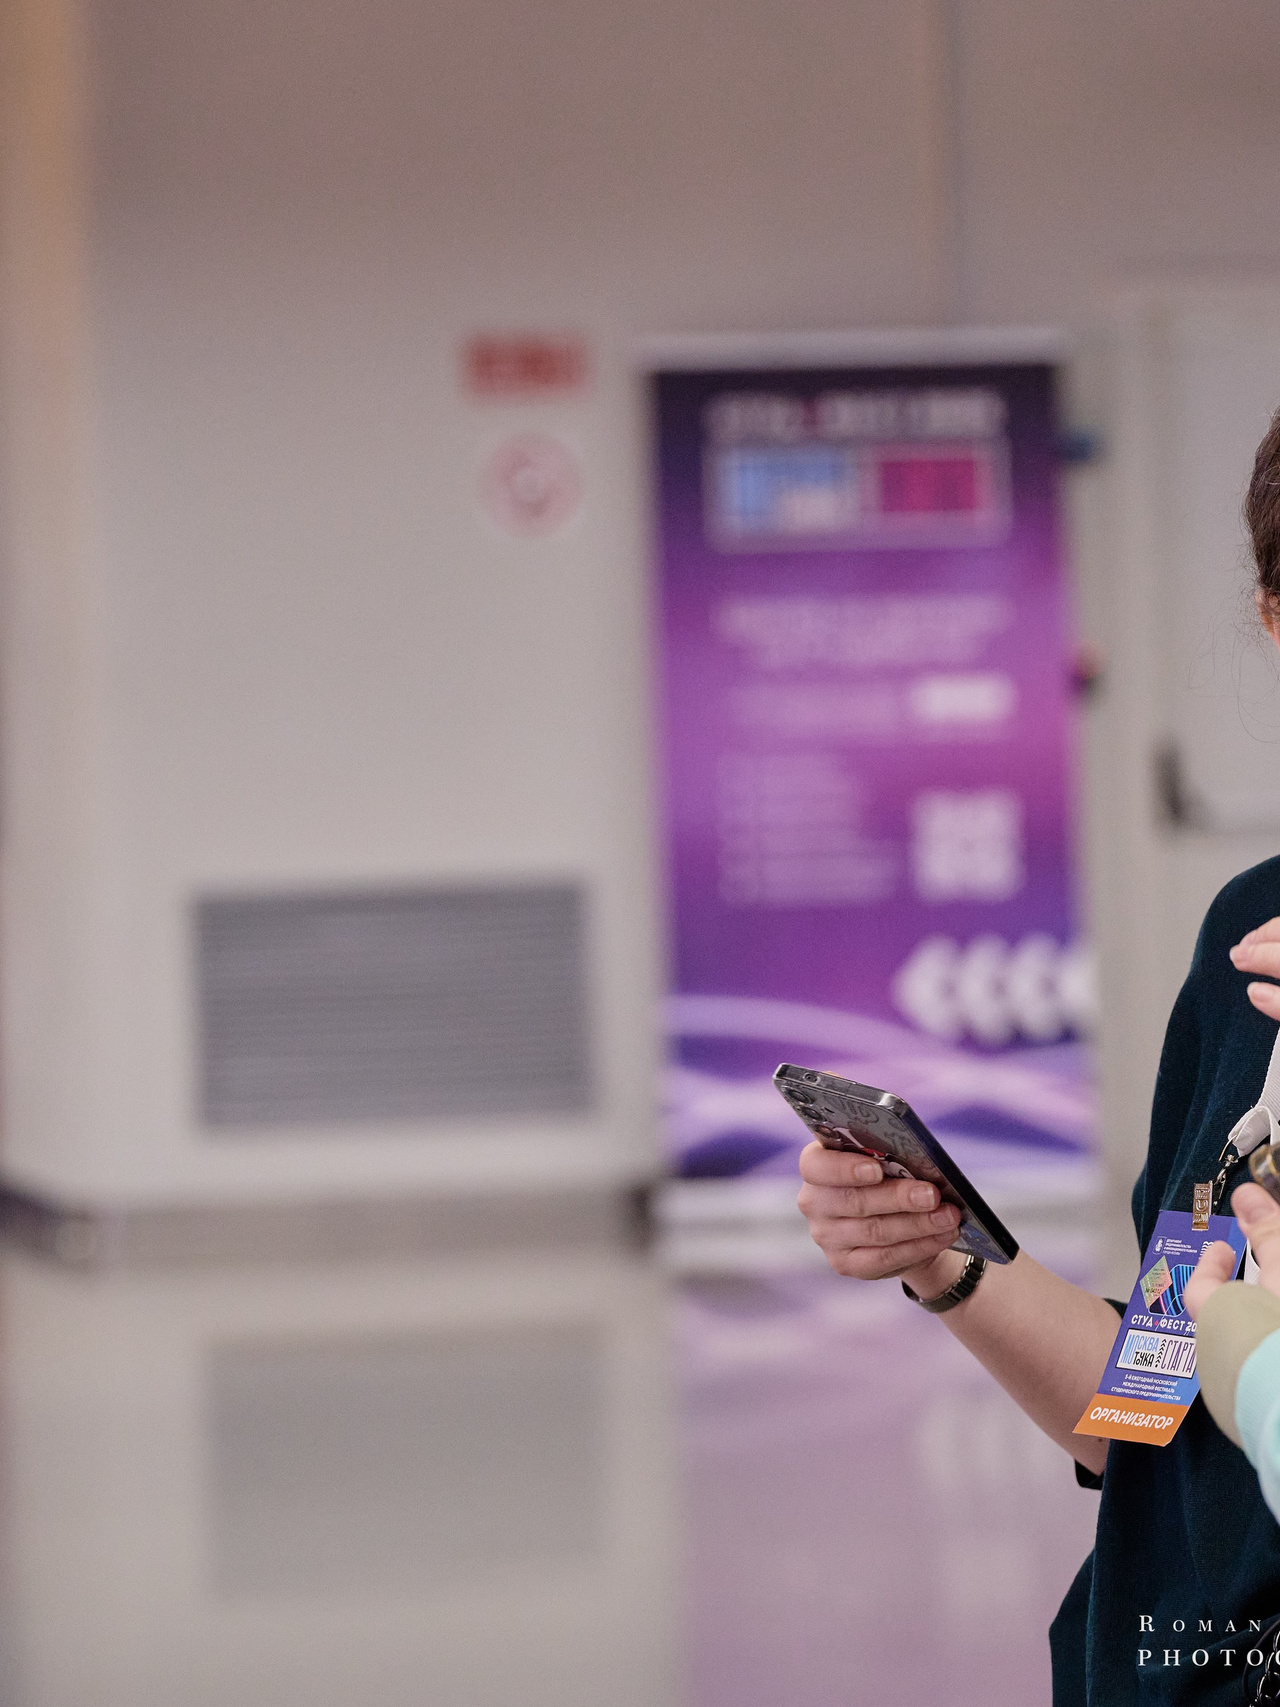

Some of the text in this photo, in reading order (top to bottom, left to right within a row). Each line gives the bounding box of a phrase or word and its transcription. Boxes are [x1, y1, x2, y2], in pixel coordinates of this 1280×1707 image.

[1160, 1318, 1185, 1331] ФЕСТ
[1185, 1321, 1197, 1332] 20
[1121, 1334, 1159, 1365] МОСКВА
[1161, 1339, 1196, 1373] СТАРТА
[1090, 1406, 1174, 1430] ОРГАНИЗАТОР
